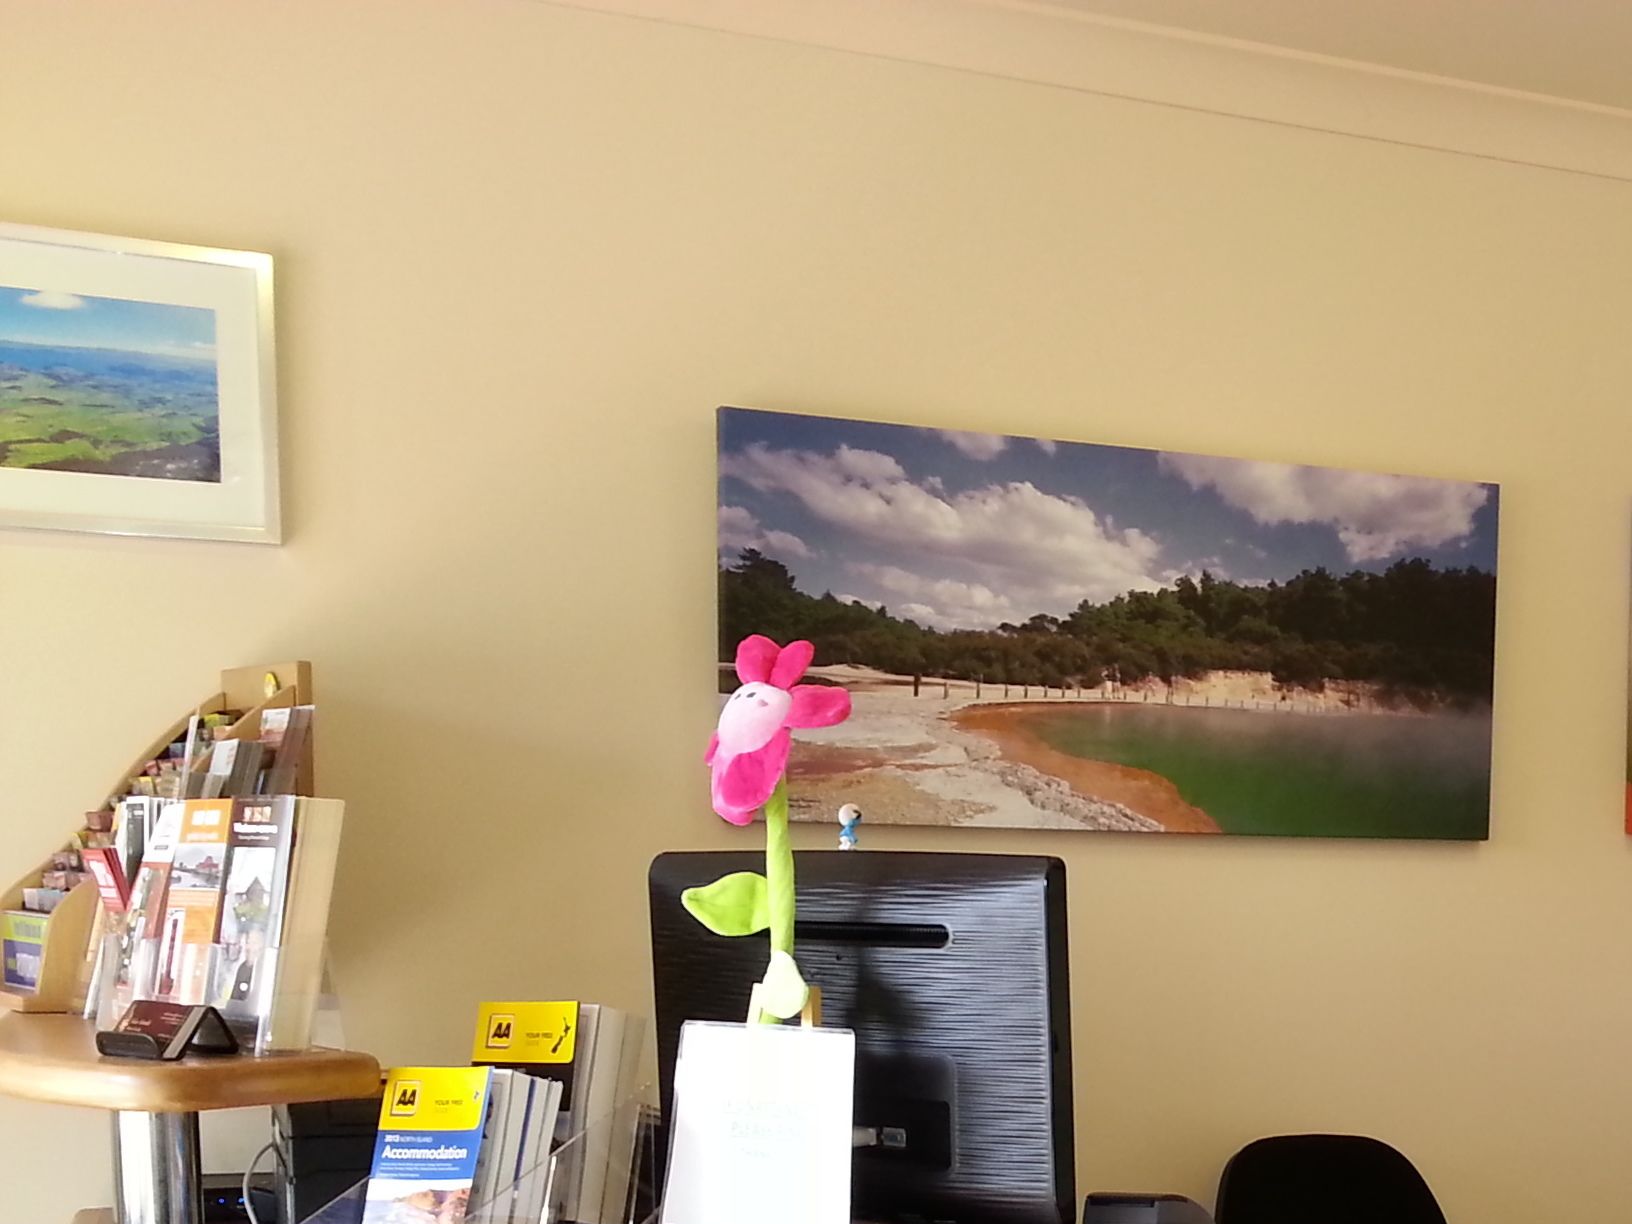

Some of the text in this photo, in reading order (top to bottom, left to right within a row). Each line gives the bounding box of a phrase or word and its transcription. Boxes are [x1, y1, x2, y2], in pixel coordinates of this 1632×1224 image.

[491, 1021, 513, 1040] AA
[395, 1088, 417, 1107] AA
[381, 1144, 468, 1160] Accommodation
